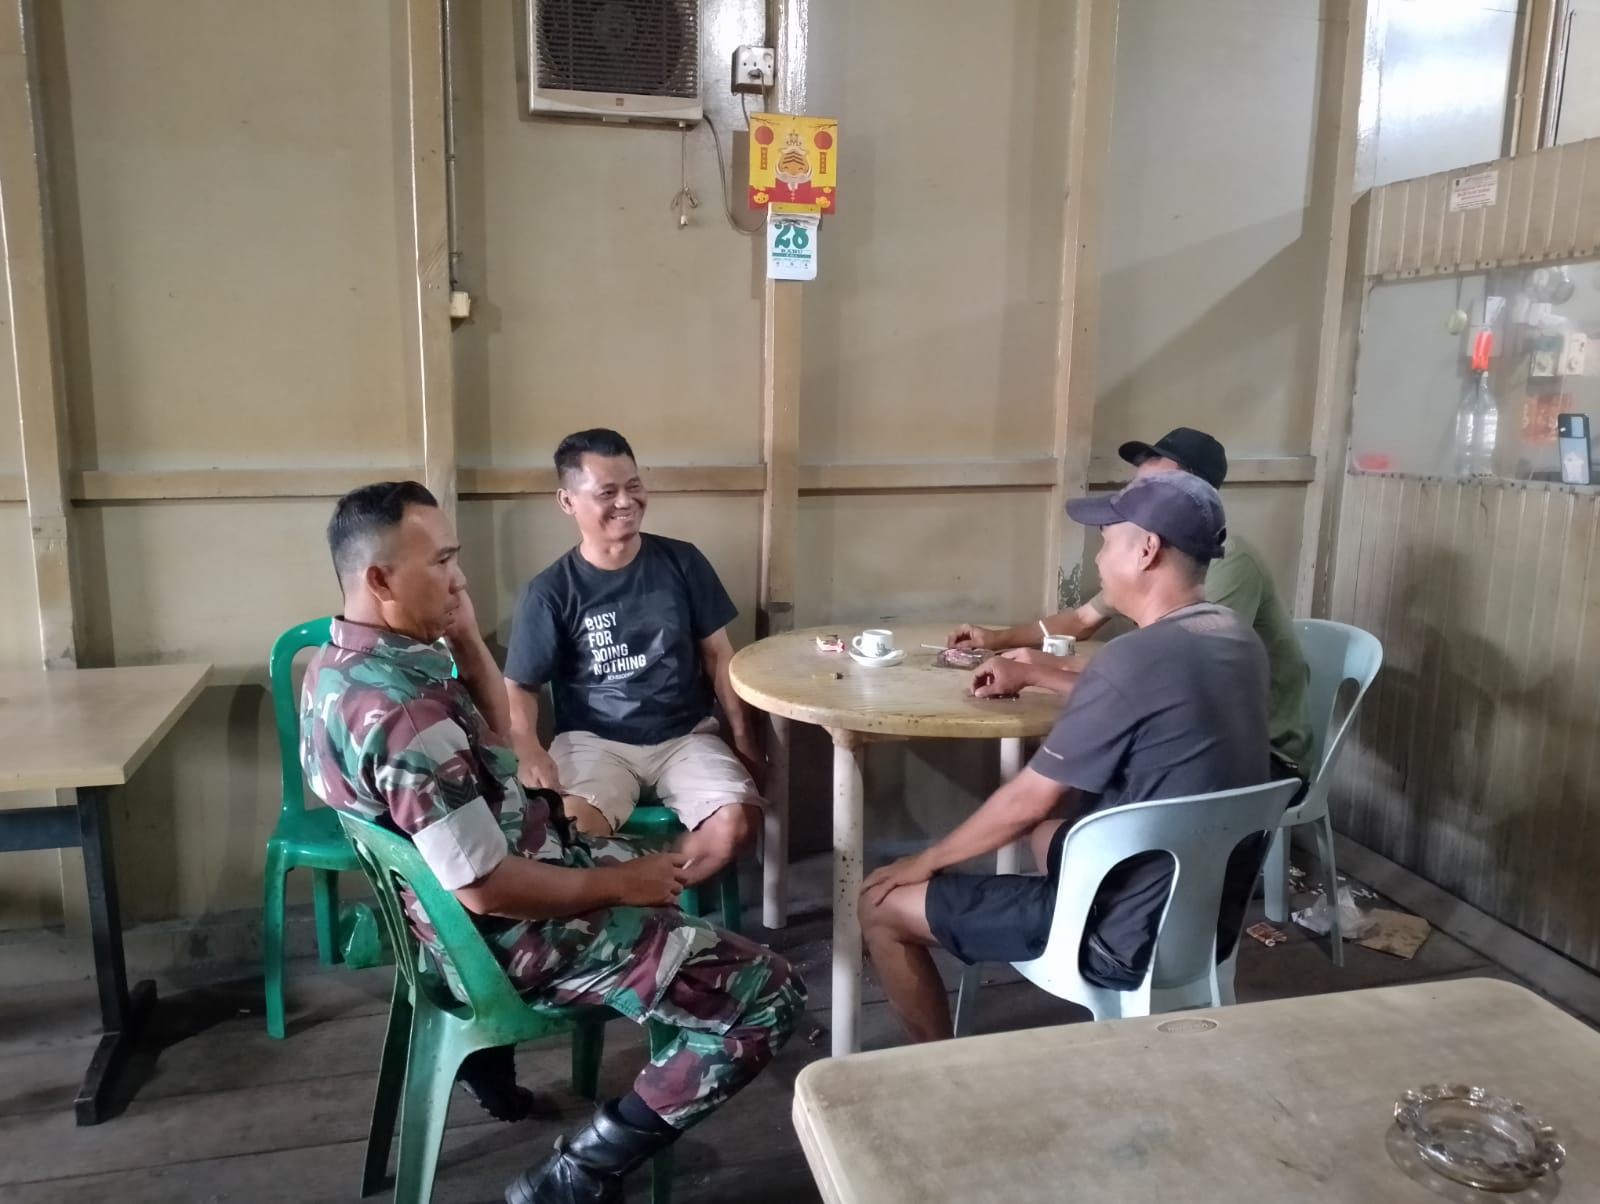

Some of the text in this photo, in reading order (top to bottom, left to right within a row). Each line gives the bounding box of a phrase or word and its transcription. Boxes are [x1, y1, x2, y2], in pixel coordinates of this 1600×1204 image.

[584, 611, 617, 631] BUSY
[588, 630, 614, 648] FOR
[591, 643, 629, 662] DOING
[593, 653, 647, 676] NOTHING
